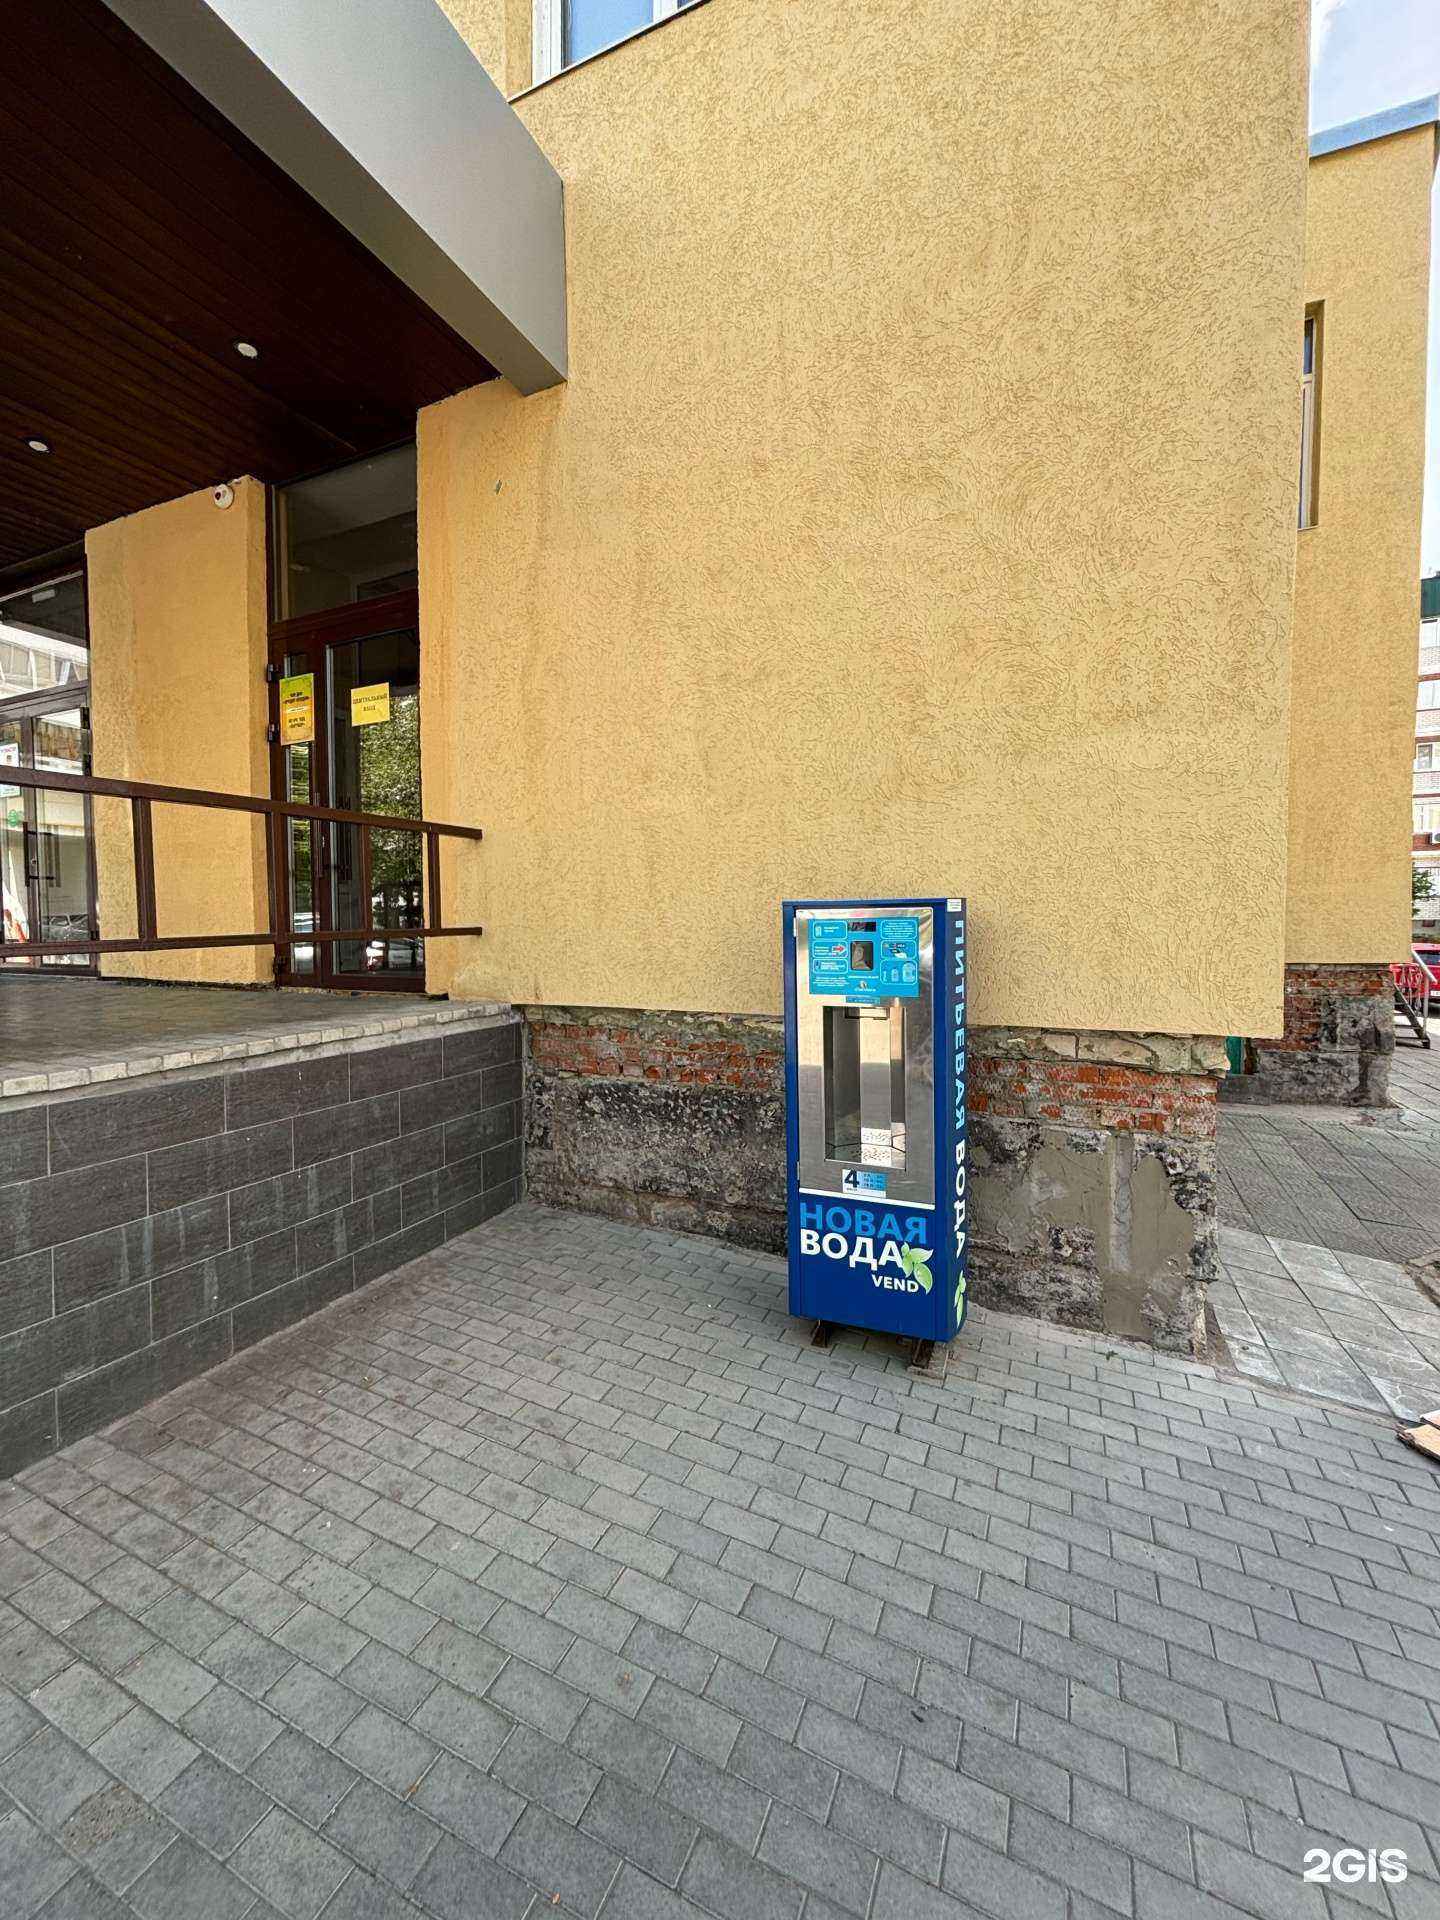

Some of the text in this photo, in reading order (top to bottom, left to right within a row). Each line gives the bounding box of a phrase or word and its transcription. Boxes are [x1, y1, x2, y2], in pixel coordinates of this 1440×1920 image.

[954, 919, 966, 1259] ПИТЬЕВАЯ ВОДА
[844, 1169, 860, 1188] 4
[800, 1202, 927, 1244] НОВАЯ
[800, 1228, 904, 1271] ВОДА
[872, 1273, 919, 1293] VEND
